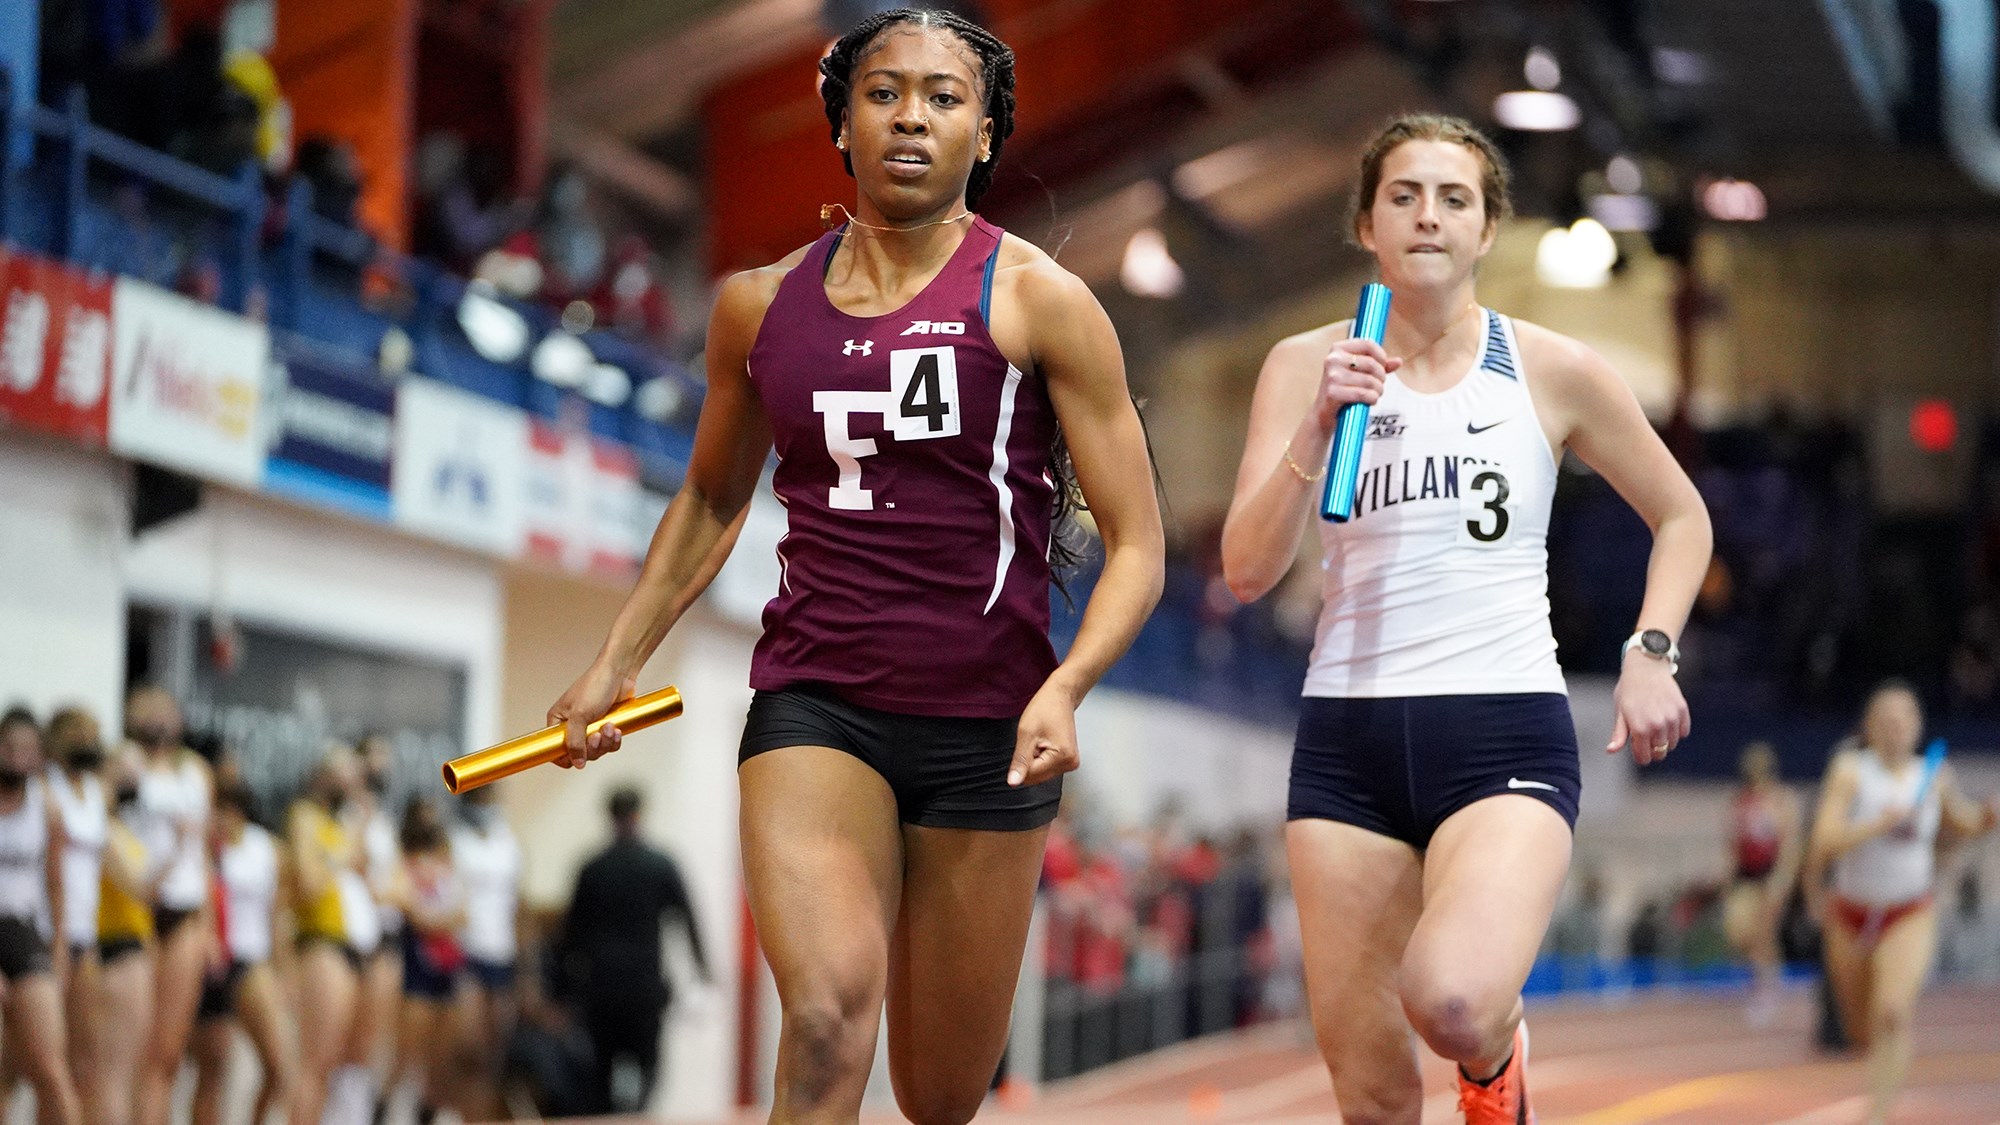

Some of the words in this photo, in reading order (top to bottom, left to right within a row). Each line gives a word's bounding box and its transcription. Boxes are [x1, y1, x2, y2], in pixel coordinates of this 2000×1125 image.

[899, 320, 966, 336] A10
[900, 353, 949, 432] 4
[812, 391, 893, 511] F
[1369, 426, 1406, 437] AST
[1353, 455, 1502, 521] VILLAN
[1466, 471, 1510, 542] 3
